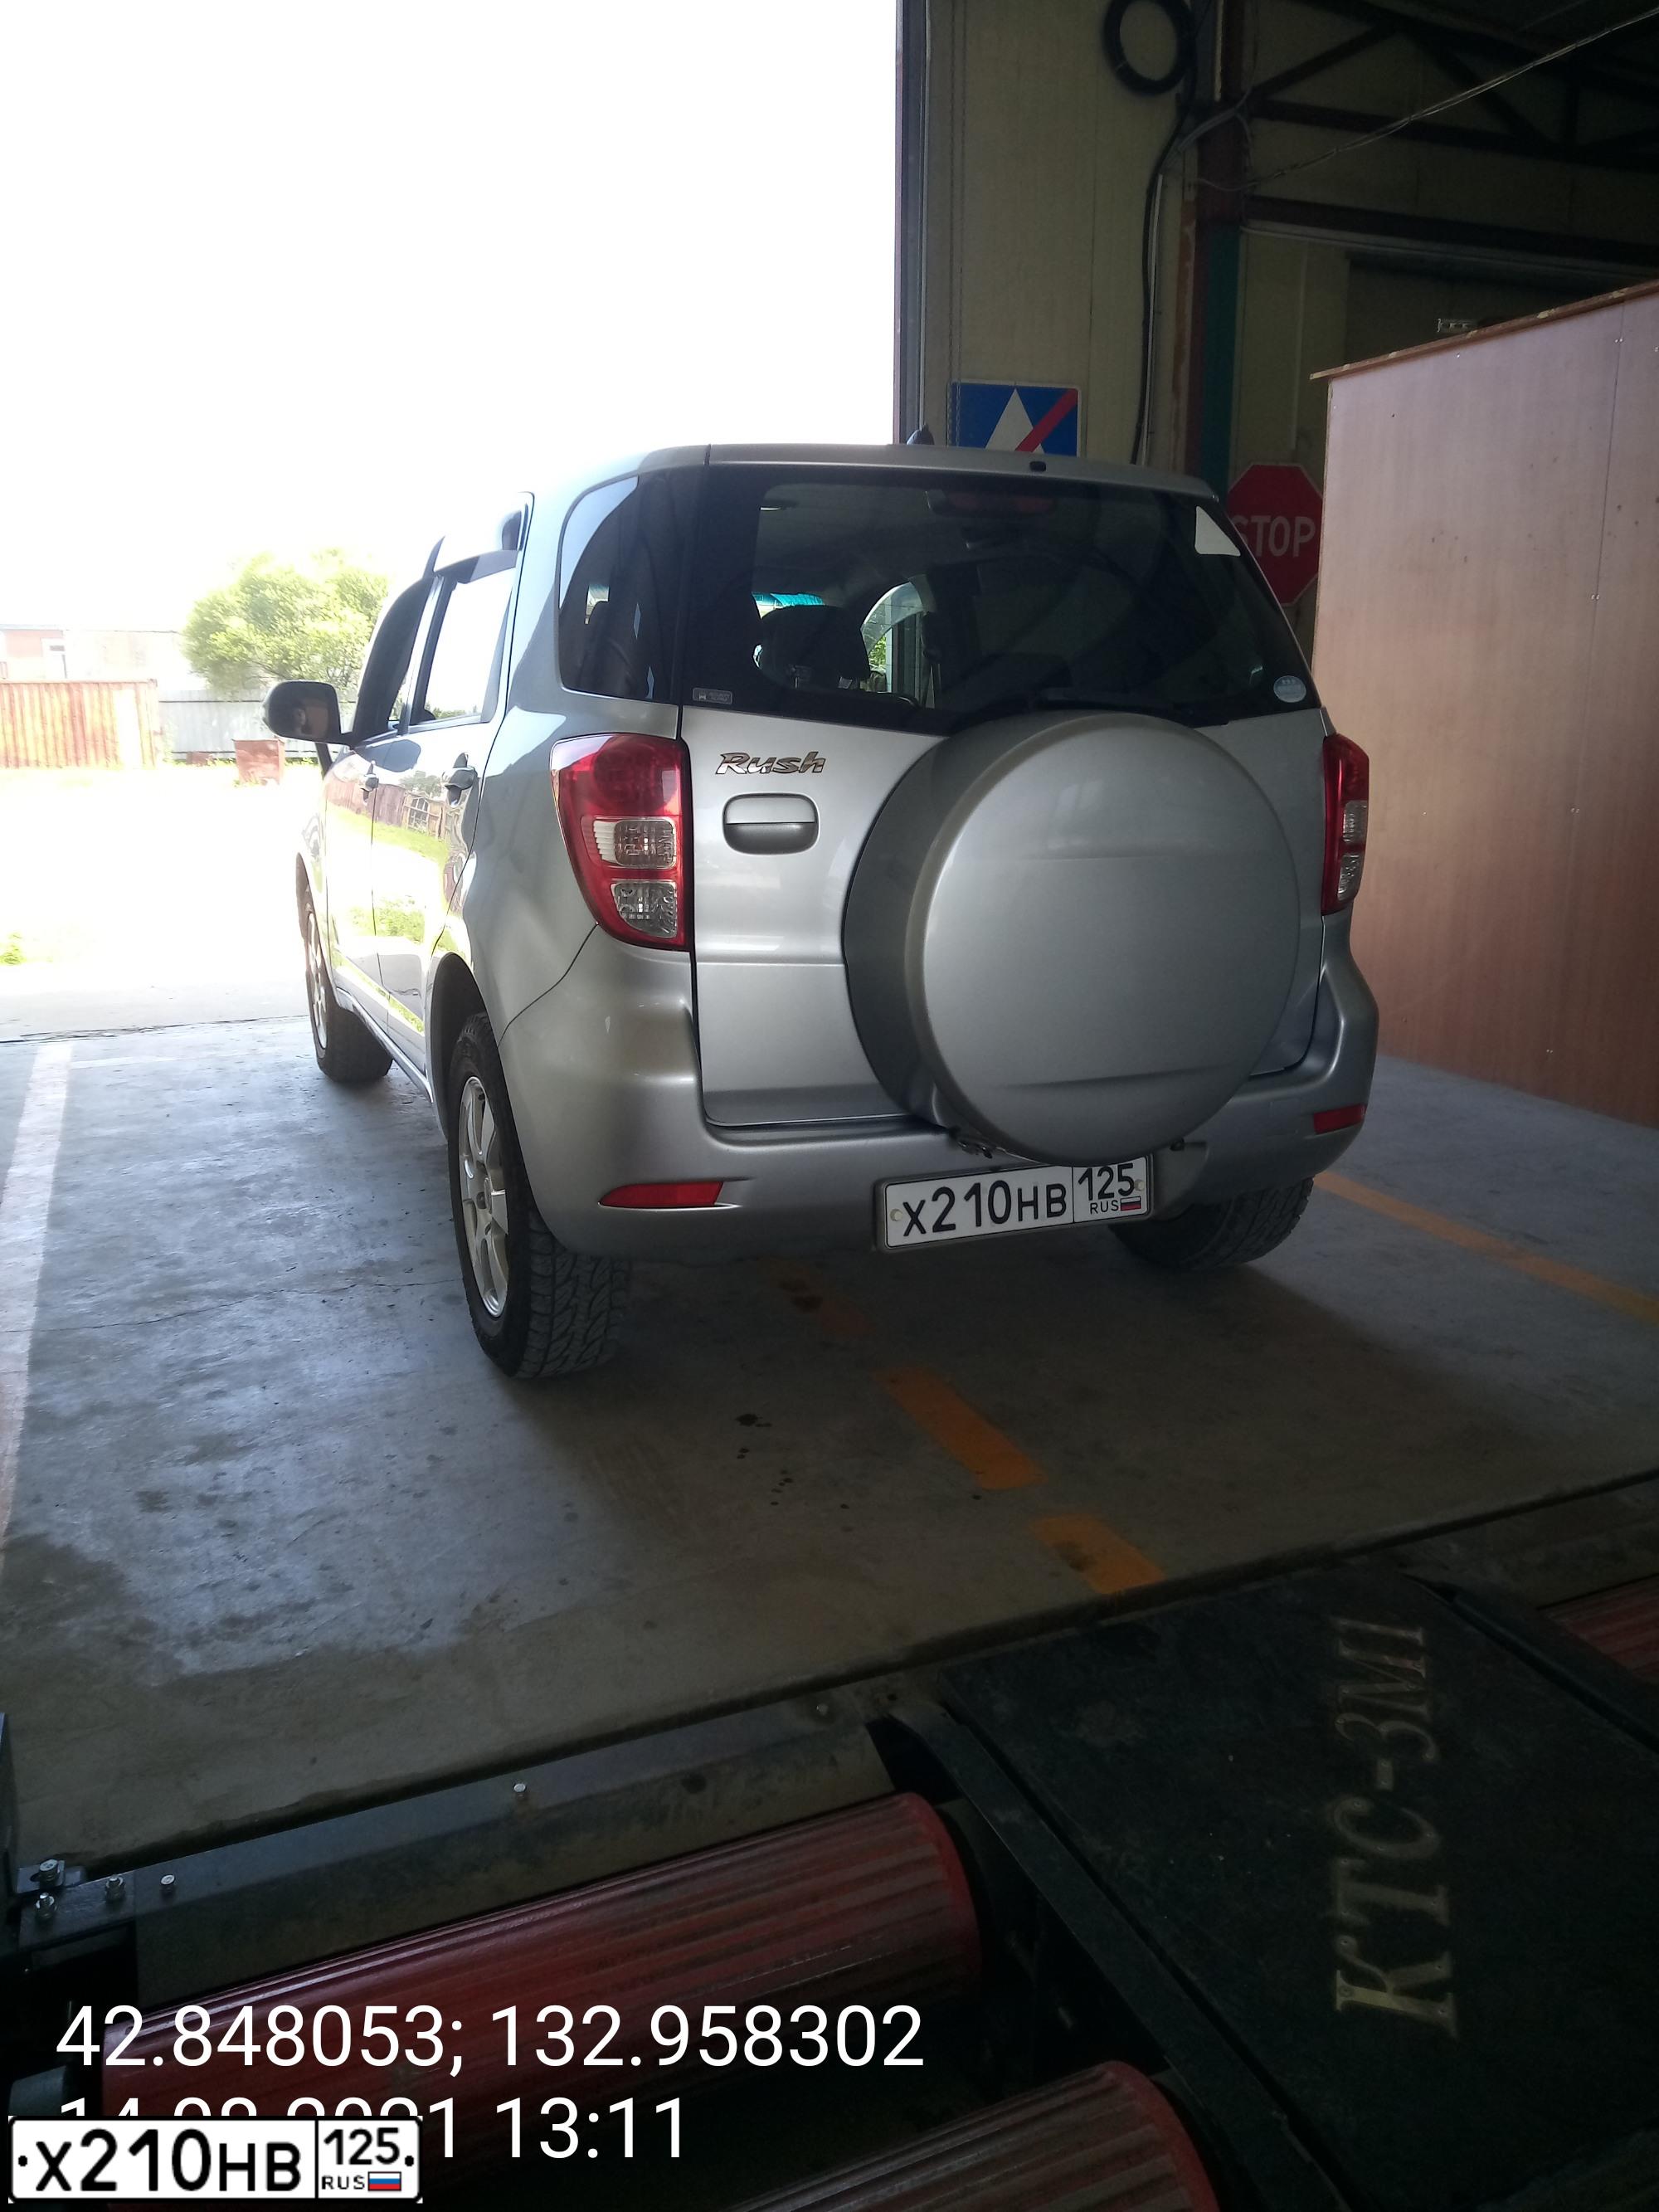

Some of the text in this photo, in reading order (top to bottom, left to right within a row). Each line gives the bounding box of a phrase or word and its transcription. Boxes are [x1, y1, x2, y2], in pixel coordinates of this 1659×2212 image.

[715, 751, 826, 775] Rush
[1078, 1162, 1135, 1201] 125
[1089, 1200, 1120, 1215] RUS
